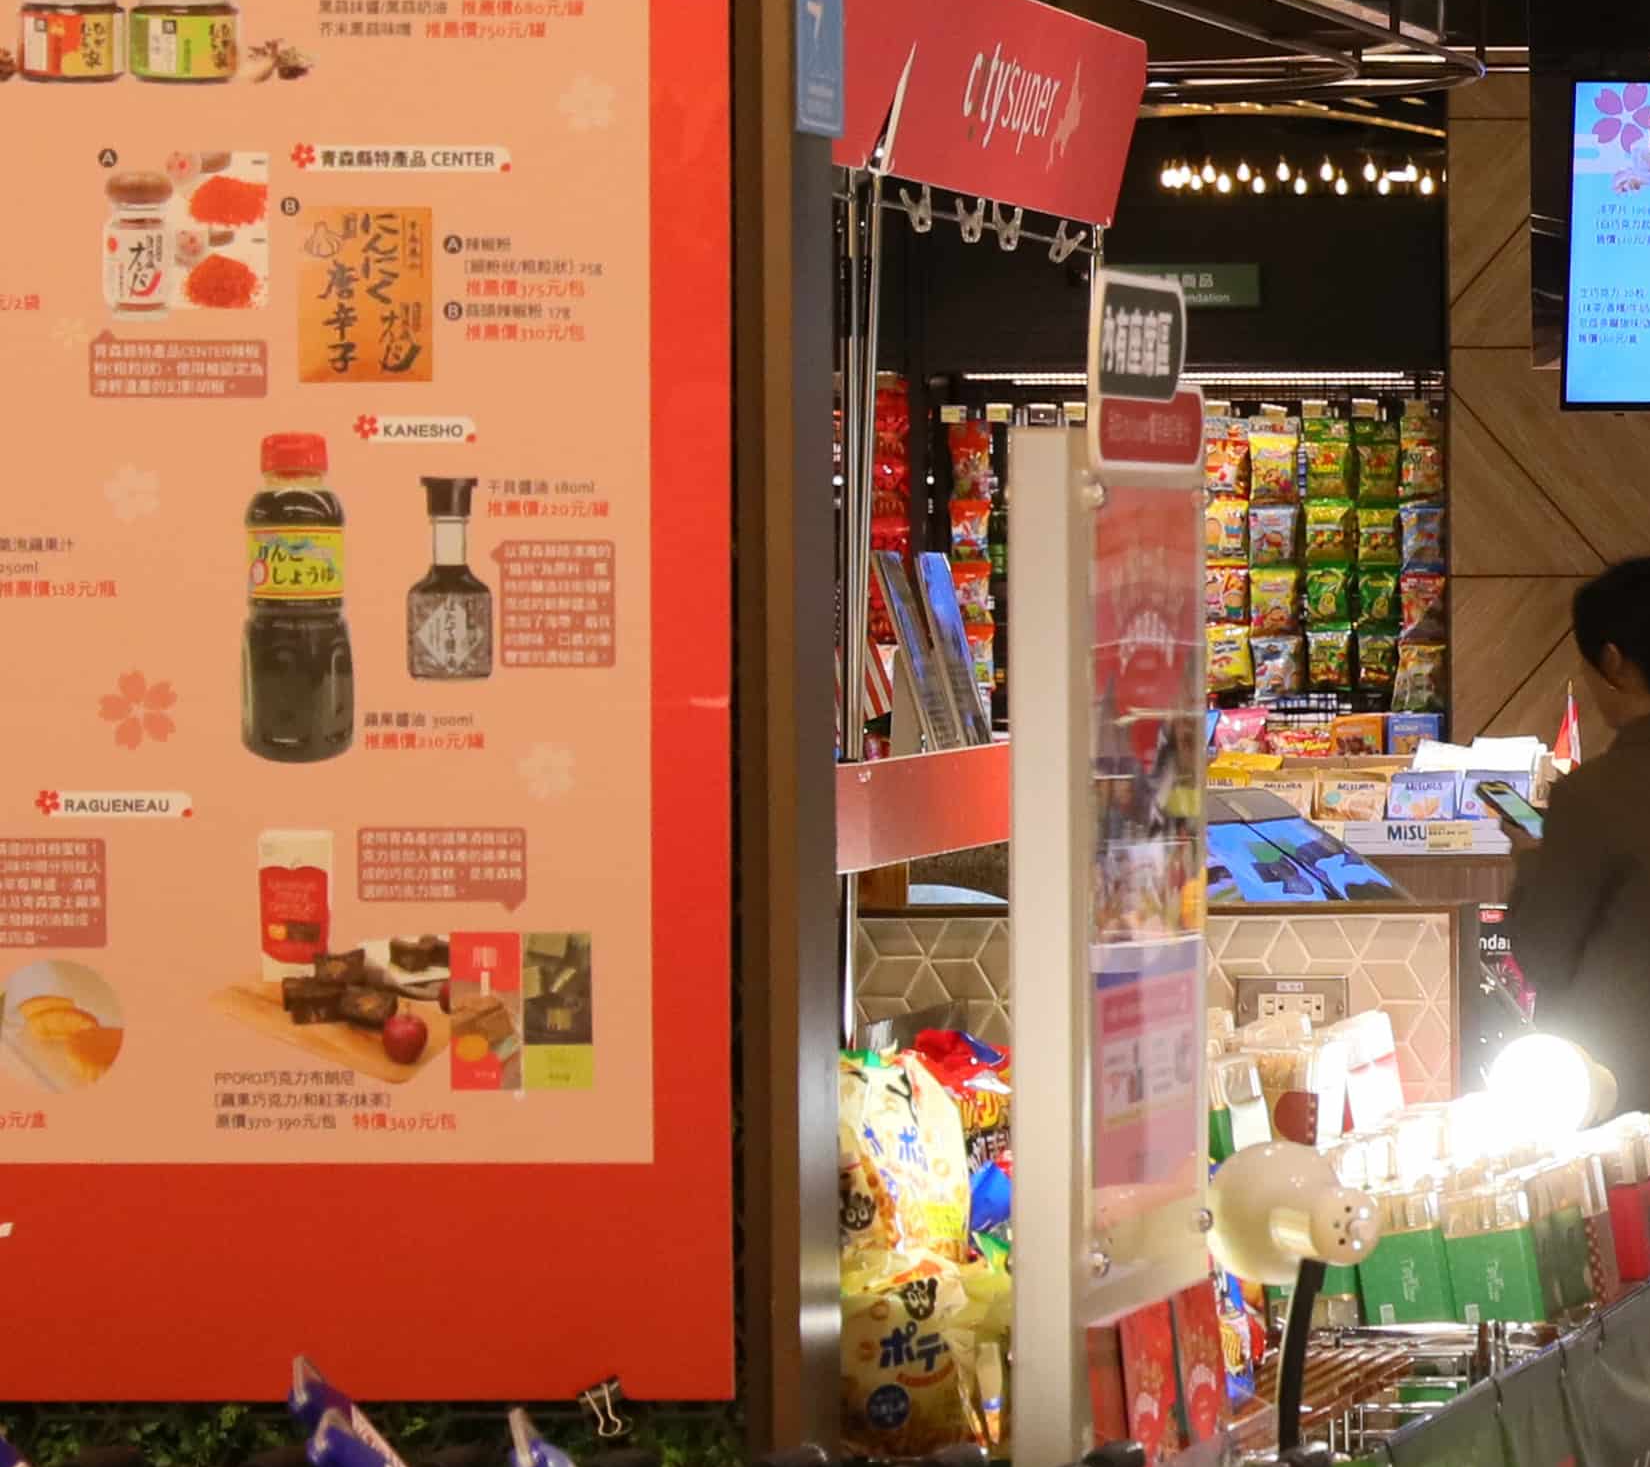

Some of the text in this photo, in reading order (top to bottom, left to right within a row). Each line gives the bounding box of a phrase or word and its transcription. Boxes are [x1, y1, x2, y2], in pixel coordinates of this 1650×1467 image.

[431, 151, 495, 167] CENTER
[382, 424, 464, 438] KANESHO
[270, 565, 338, 586] しょうゆ
[63, 798, 170, 814] RAGUENEAU
